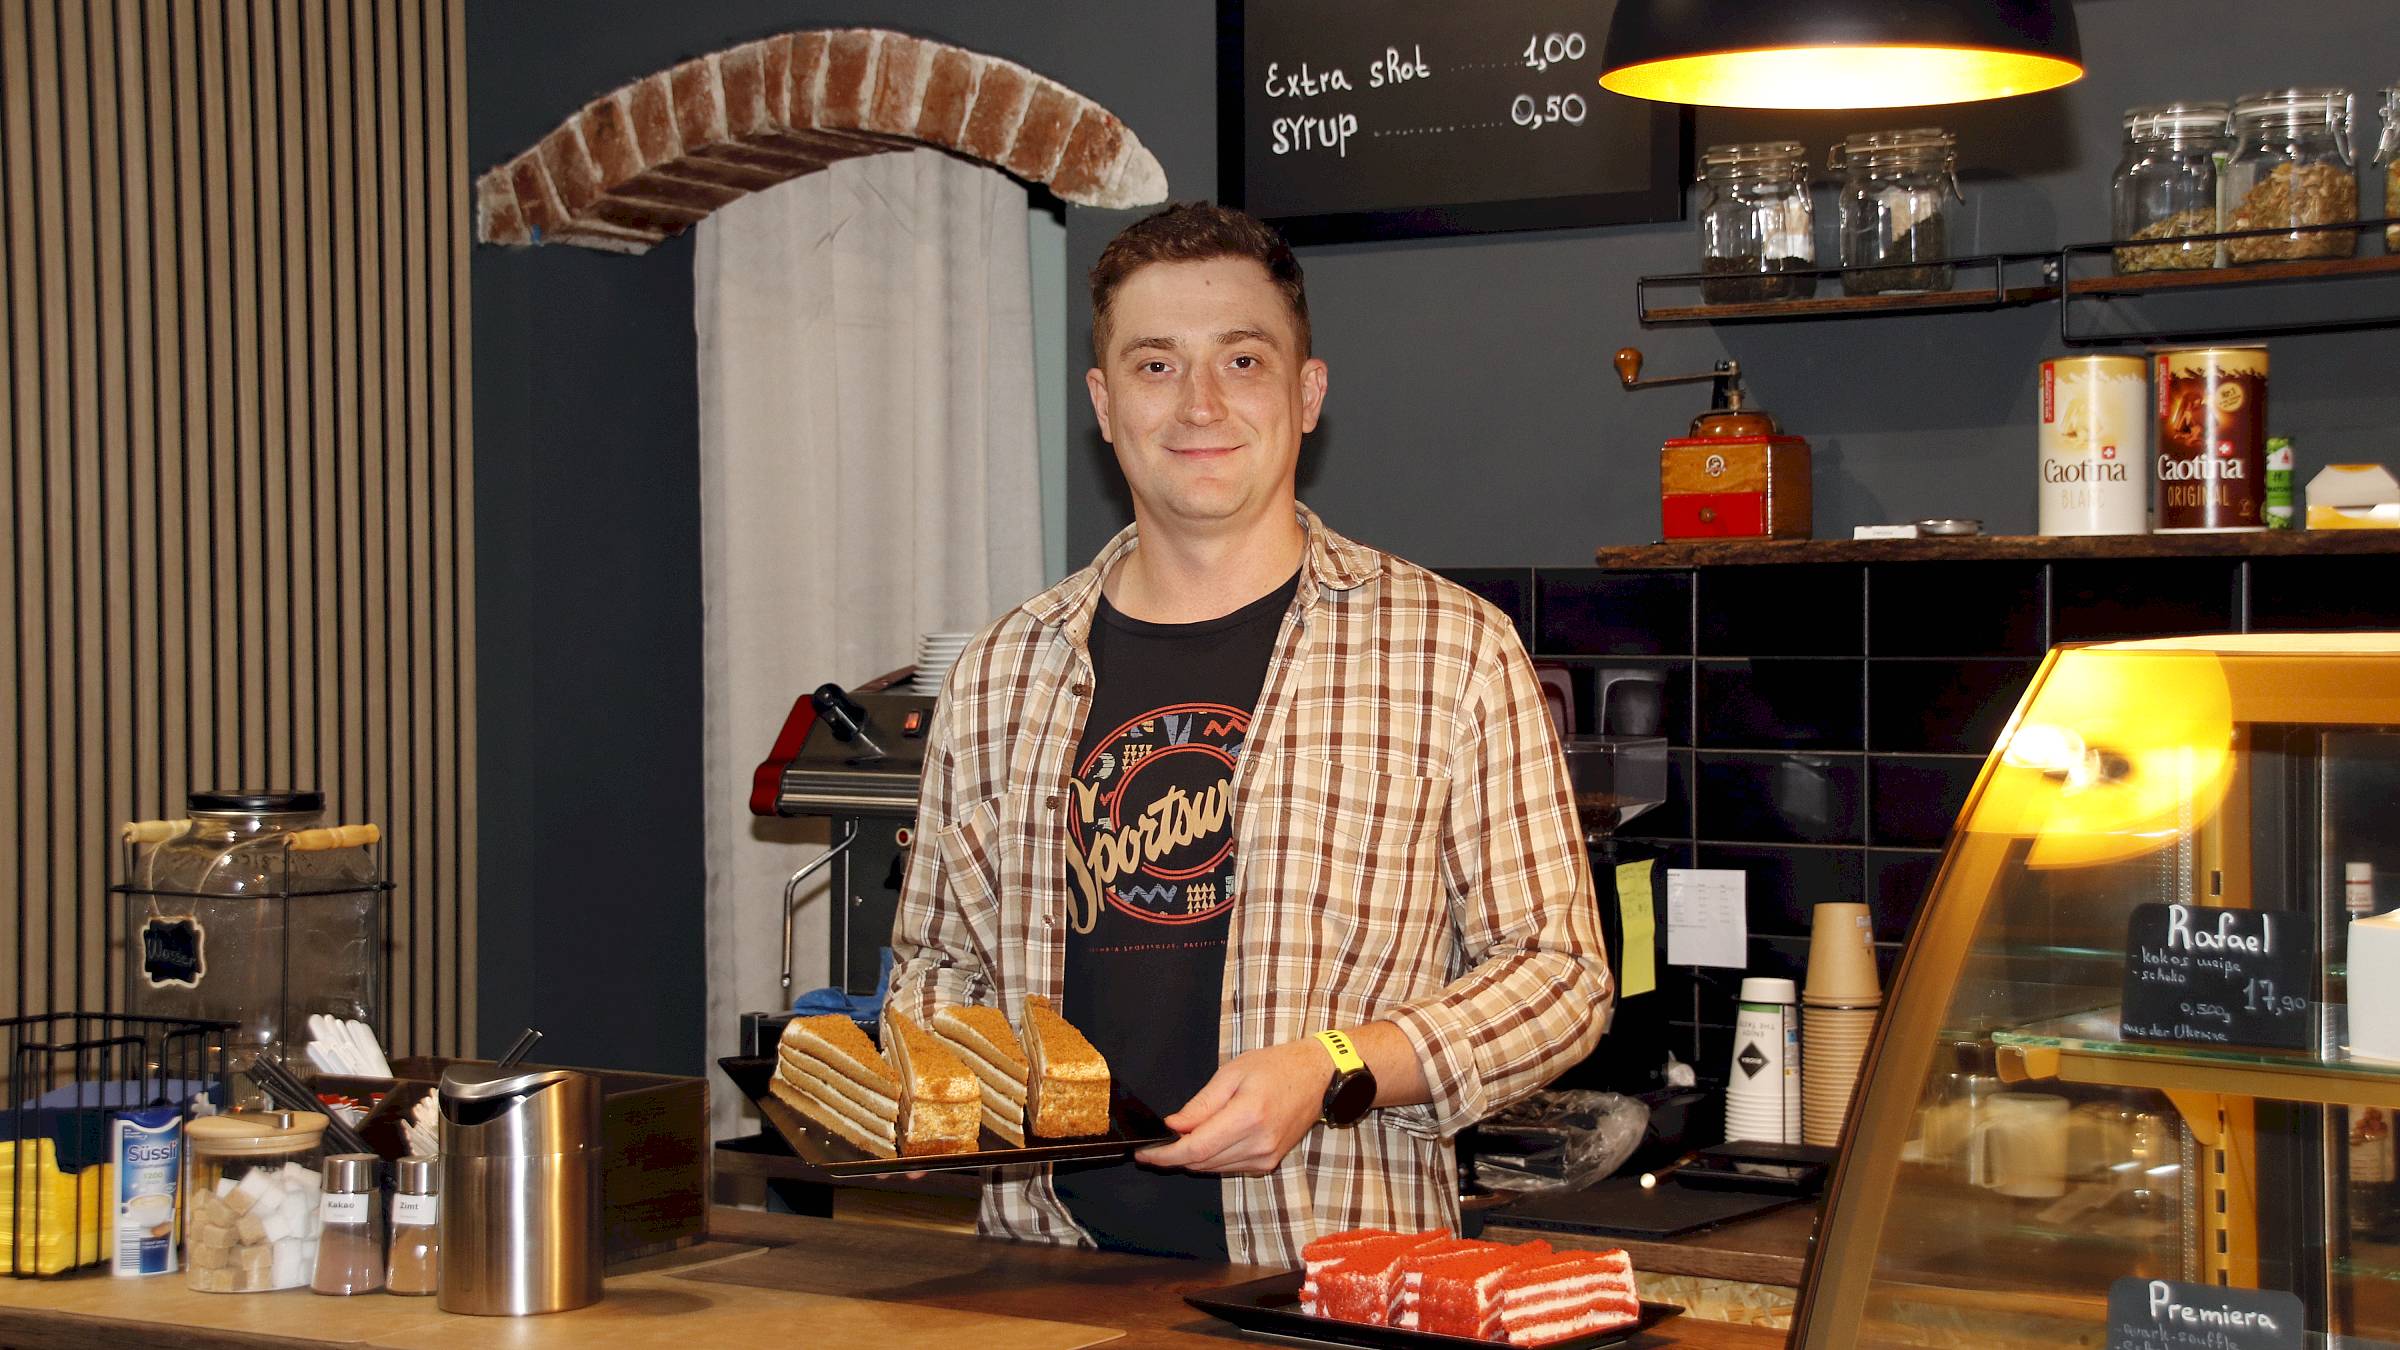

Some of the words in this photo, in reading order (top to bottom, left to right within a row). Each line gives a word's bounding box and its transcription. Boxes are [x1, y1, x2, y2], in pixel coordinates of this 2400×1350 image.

[1265, 63, 1352, 98] Extra
[1523, 33, 1586, 72] 1,00
[1510, 94, 1587, 130] 0,50
[2044, 459, 2127, 483] Caotina
[2157, 455, 2243, 480] Caotina
[2166, 904, 2270, 953] Rafael
[2242, 977, 2307, 1017] 17,90
[127, 1139, 177, 1163] Süssli
[328, 1200, 355, 1209] Kakao
[400, 1201, 419, 1210] Zimt
[2149, 1280, 2277, 1329] Premiera
